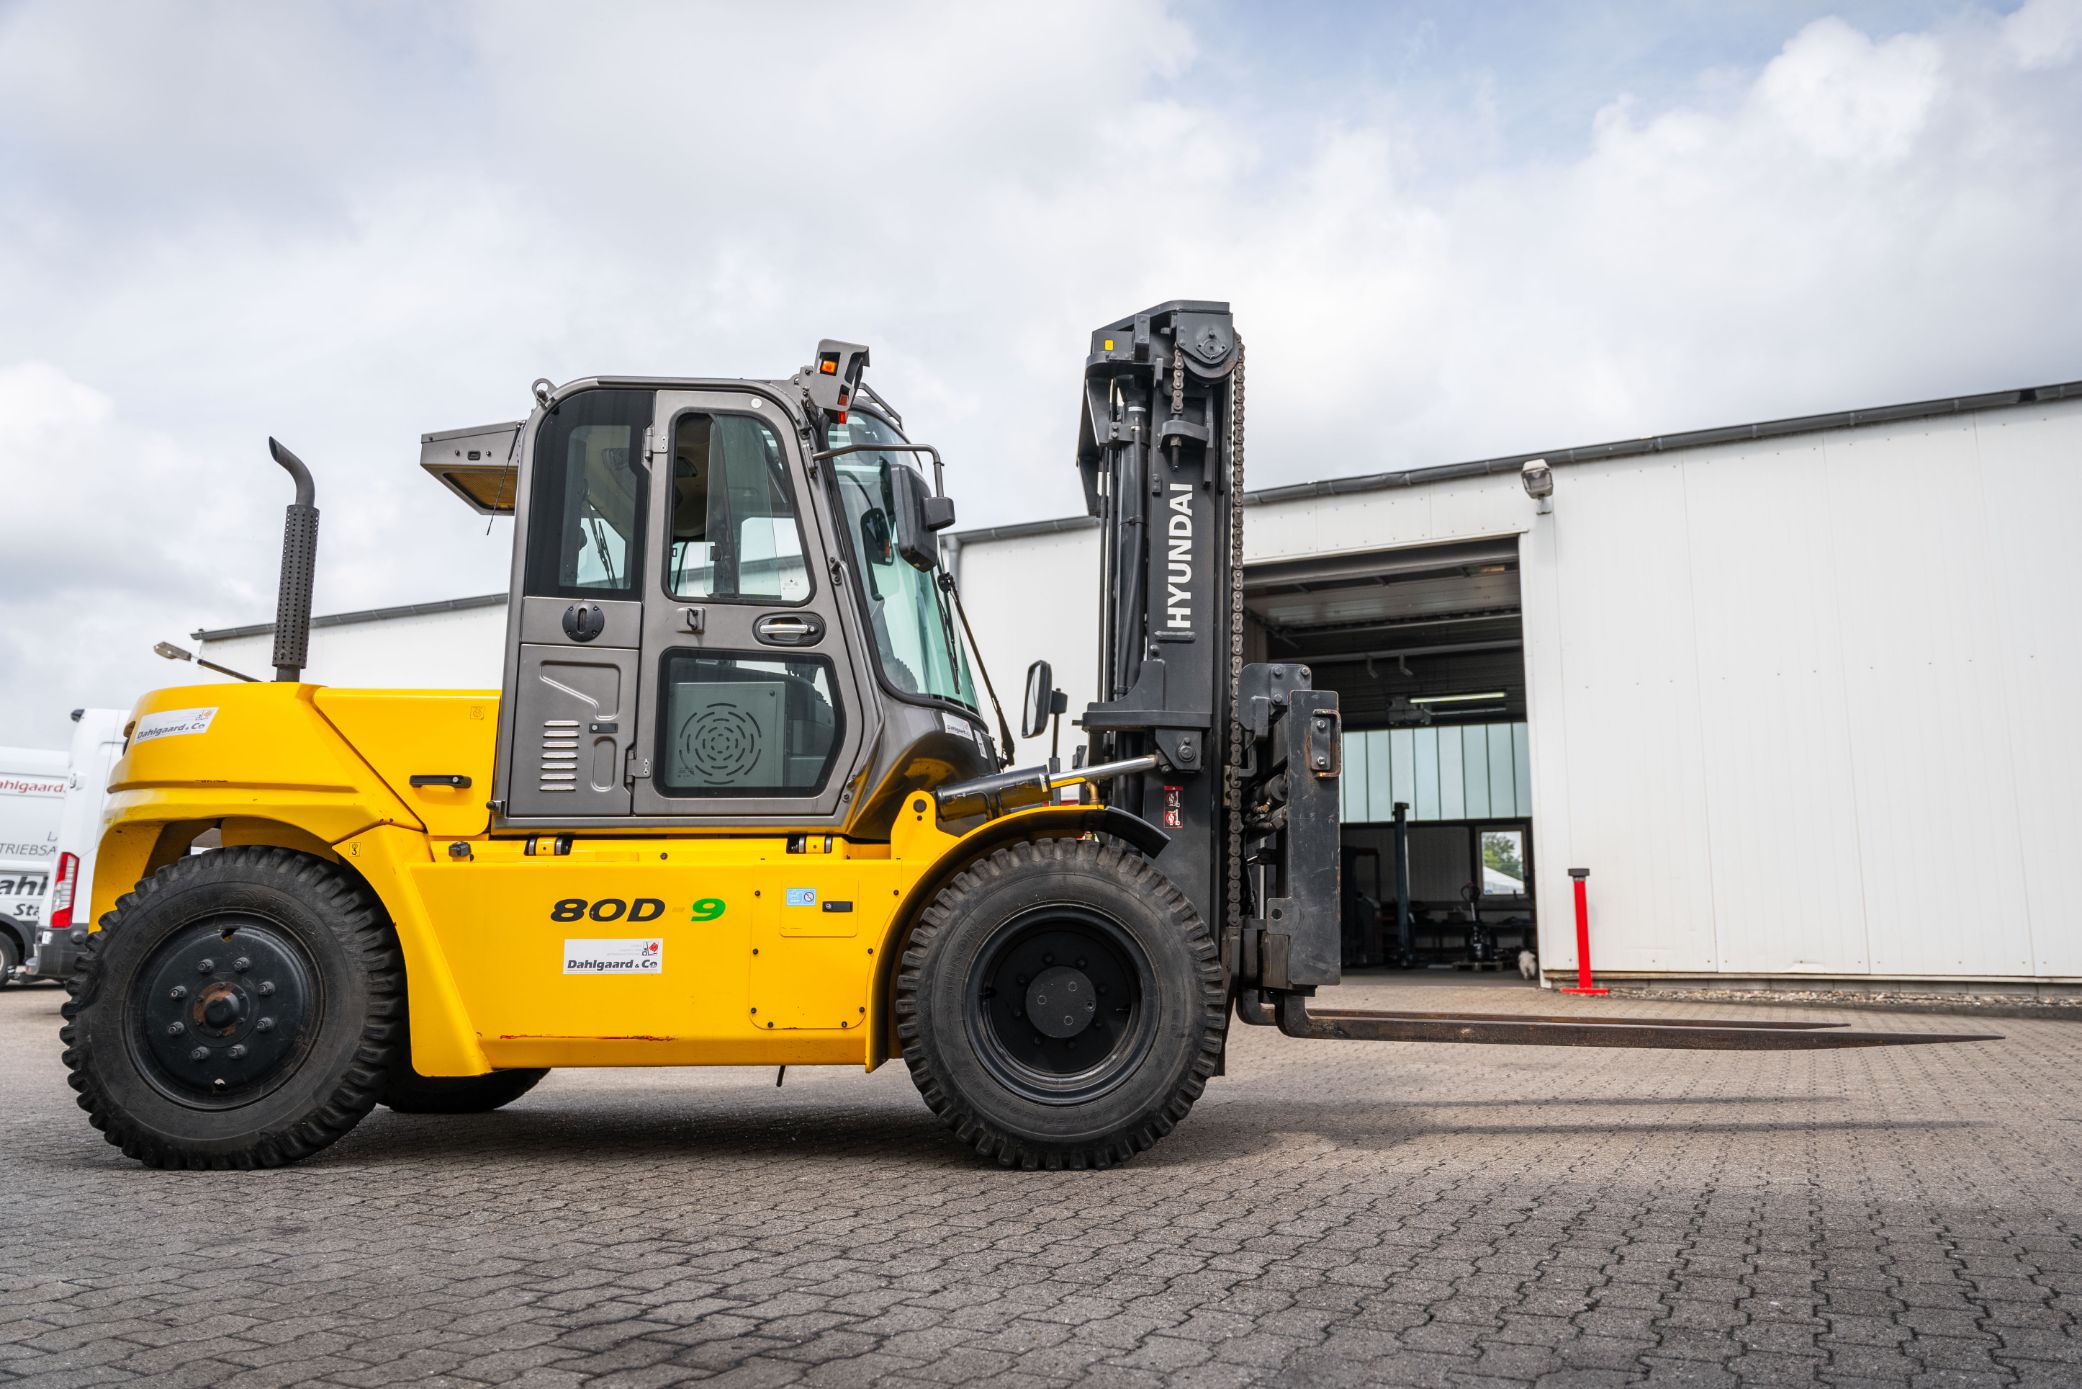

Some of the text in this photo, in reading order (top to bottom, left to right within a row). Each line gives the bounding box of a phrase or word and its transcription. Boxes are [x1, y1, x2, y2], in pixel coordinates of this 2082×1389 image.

[1167, 483, 1193, 629] HYUNDAI
[137, 723, 186, 739] Dahlgaard
[550, 898, 666, 923] 80D
[567, 959, 634, 972] Dahlgaard
[641, 959, 658, 969] Co
